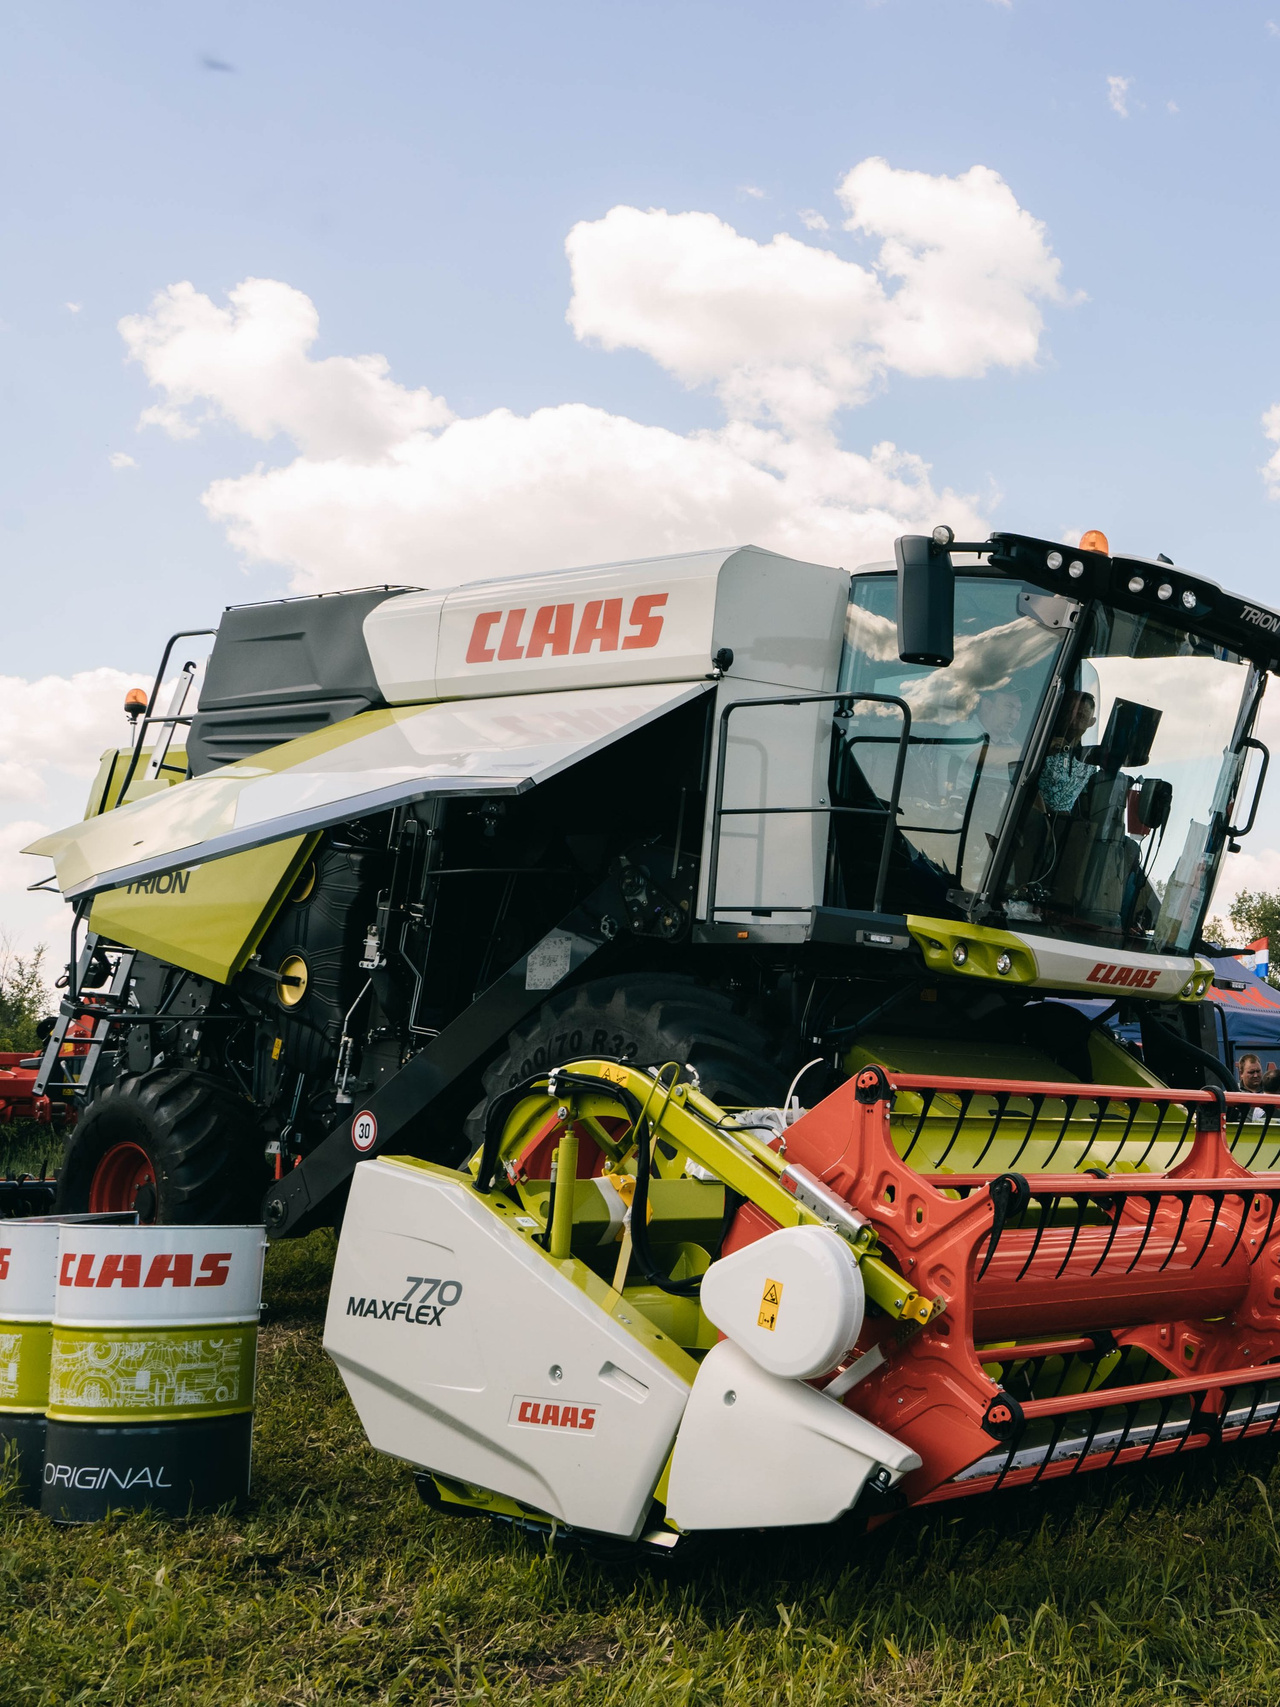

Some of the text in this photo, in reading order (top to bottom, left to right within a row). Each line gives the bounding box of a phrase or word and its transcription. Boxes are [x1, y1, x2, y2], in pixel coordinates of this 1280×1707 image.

[466, 592, 669, 664] CLAAS
[1085, 962, 1161, 990] CLAAS
[358, 1123, 371, 1139] 30
[59, 1252, 233, 1288] CLAAS
[403, 1276, 463, 1306] 770
[346, 1295, 447, 1327] MAXFLEX
[518, 1402, 596, 1430] CLAAS
[43, 1462, 172, 1489] ORIGINAL
